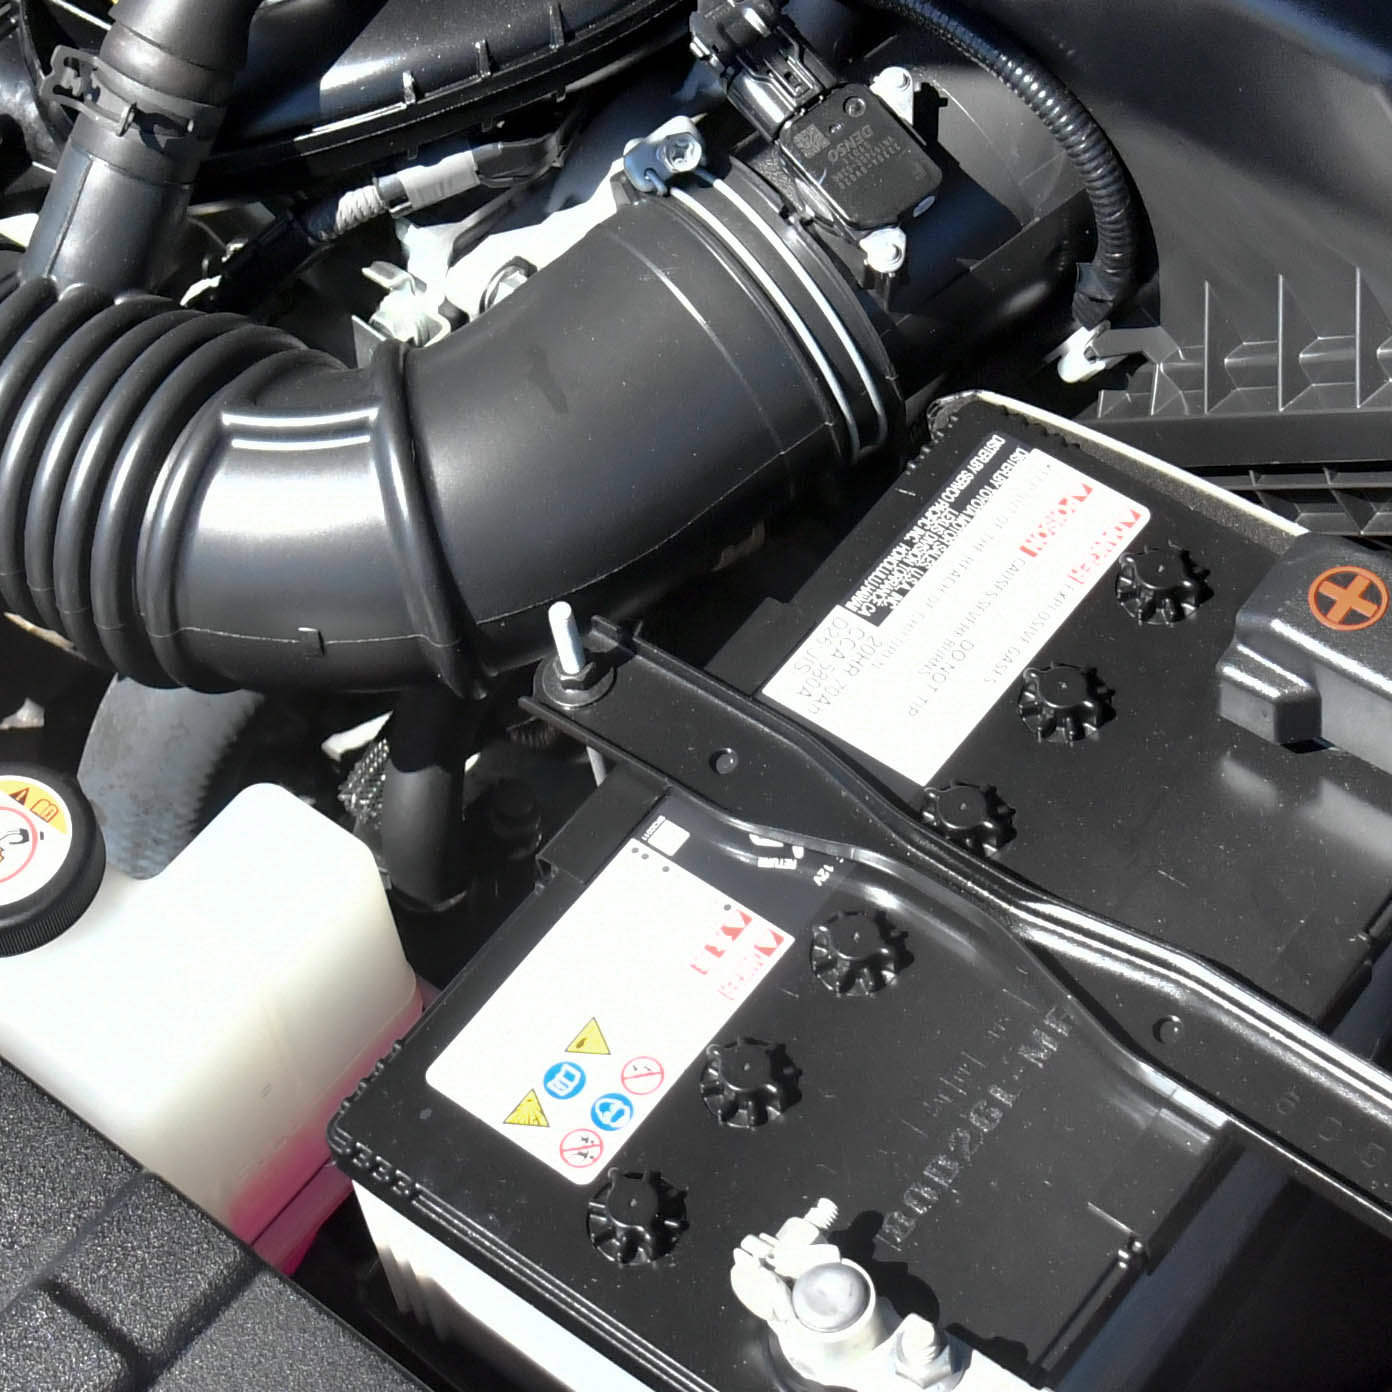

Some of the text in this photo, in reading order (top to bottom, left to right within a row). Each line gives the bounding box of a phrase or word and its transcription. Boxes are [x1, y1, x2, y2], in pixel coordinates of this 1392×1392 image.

[824, 122, 874, 164] DENSO
[961, 484, 996, 517] TOYOTA
[928, 506, 959, 535] LEXUS
[936, 513, 970, 546] MOTOR
[900, 531, 937, 567] DIVISION
[840, 634, 884, 678] 20HR
[947, 638, 975, 664] DO
[810, 860, 836, 888] 12V
